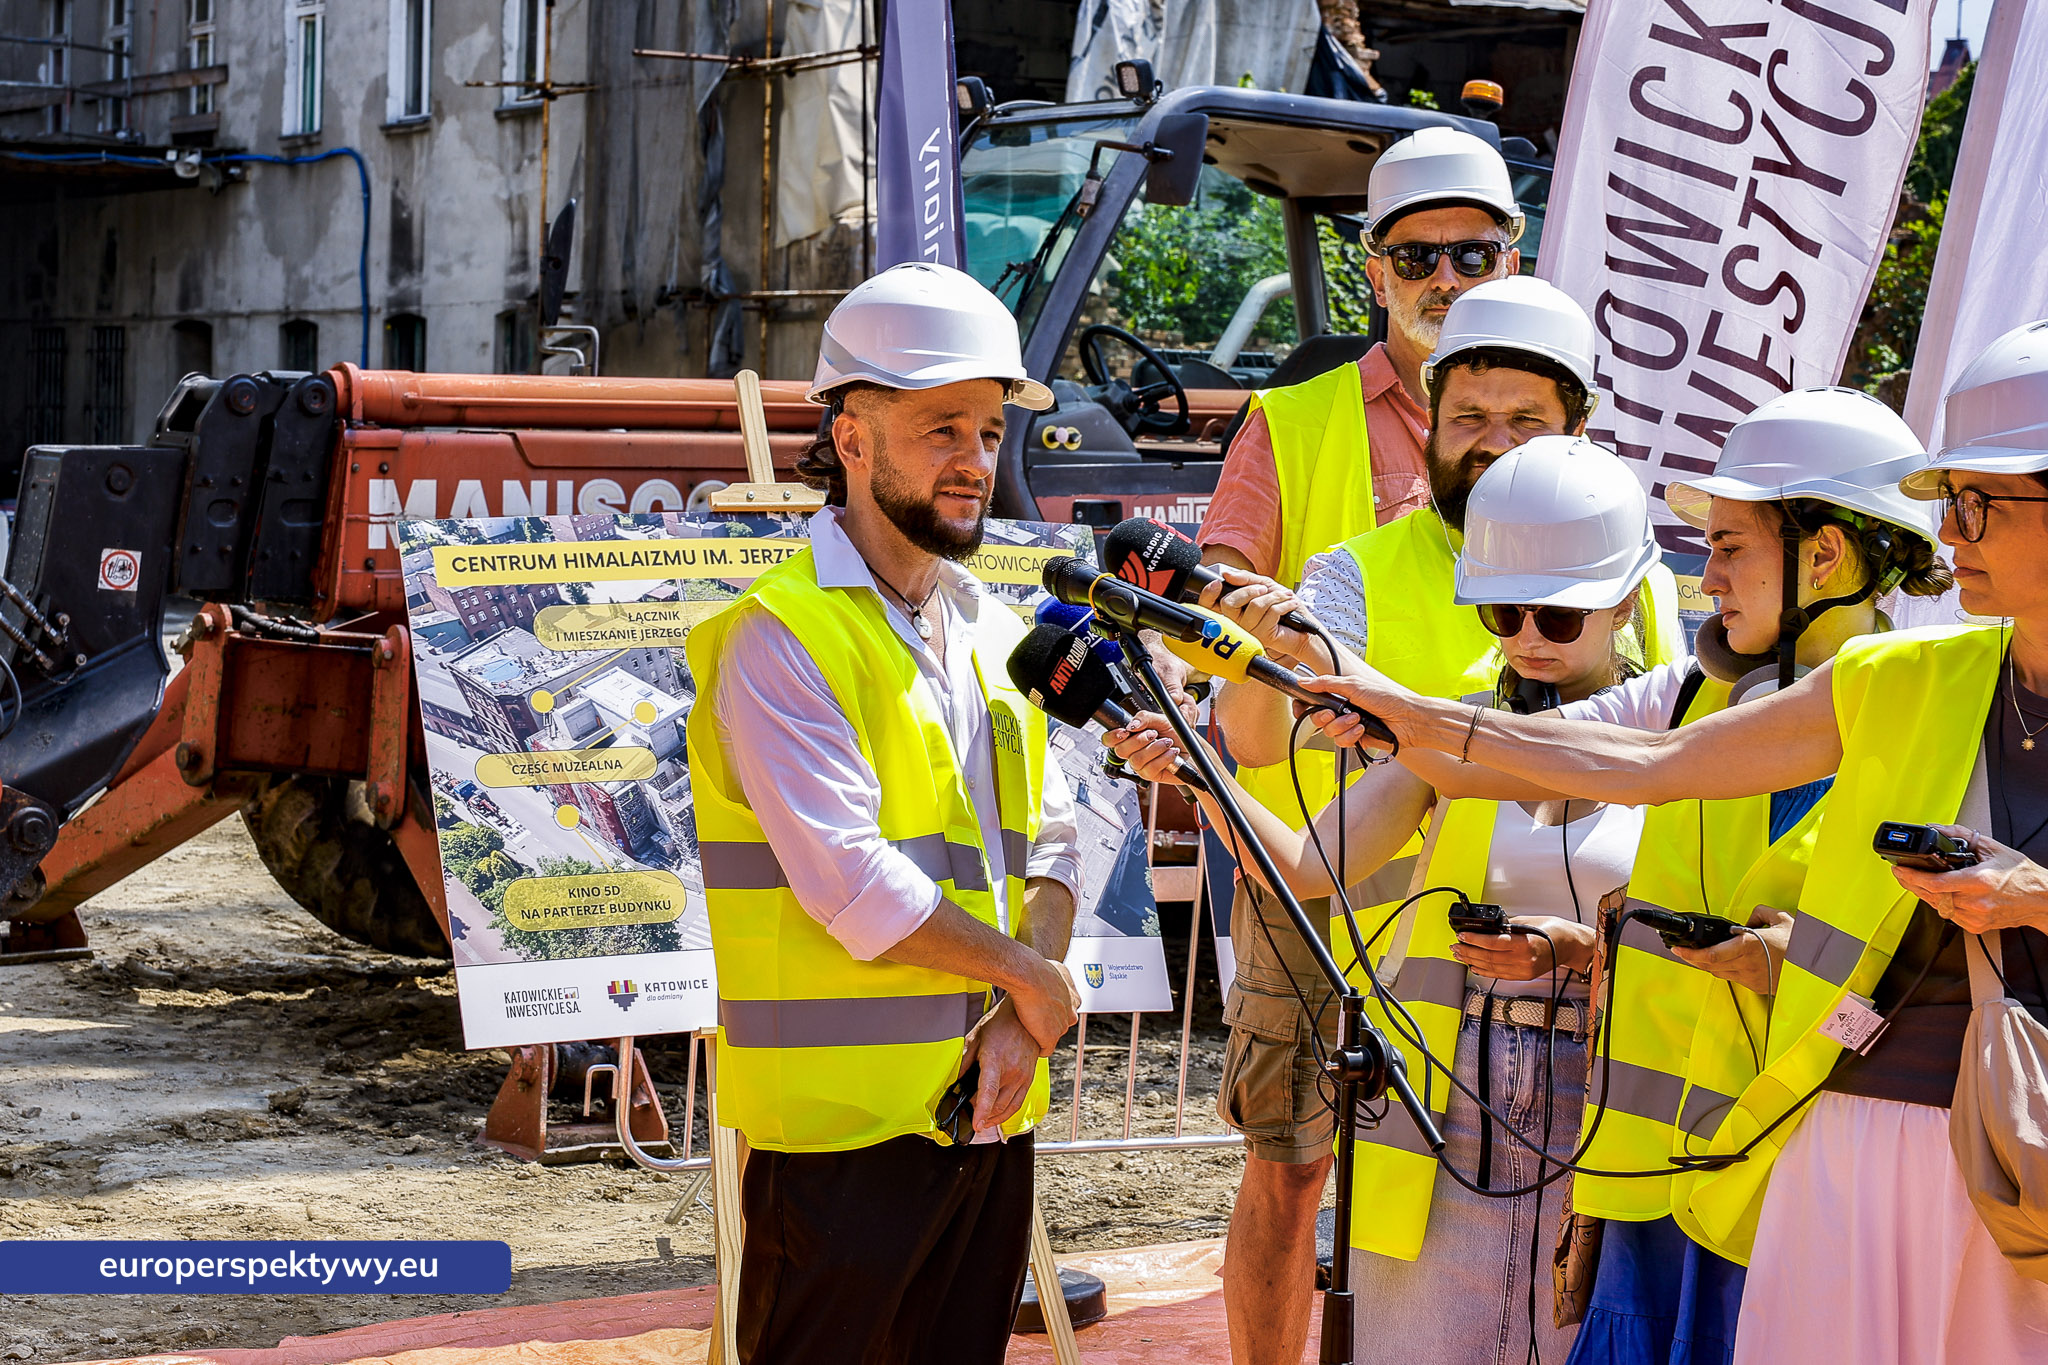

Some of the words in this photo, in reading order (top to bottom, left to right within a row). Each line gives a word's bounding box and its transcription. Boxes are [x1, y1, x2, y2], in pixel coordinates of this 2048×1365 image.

[1142, 531, 1163, 558] RADIO
[1146, 531, 1176, 572] KATOWICE
[451, 553, 557, 573] CENTRUM
[563, 549, 697, 570] HIMALAIZMU
[703, 549, 733, 565] IM.
[740, 548, 804, 564] JERZE
[628, 610, 680, 625] ŁĄCZNIK
[556, 631, 560, 642] I
[564, 629, 637, 642] MIESZKANIE
[640, 627, 691, 642] JERZEGO
[1049, 636, 1088, 695] ANTYRADIO
[511, 760, 550, 777] CZĘŚĆ
[552, 759, 623, 774] MUZEALNA
[568, 886, 601, 899] KINO
[604, 885, 621, 897] 5D
[520, 908, 541, 920] NA
[543, 904, 607, 919] PARTERZE
[609, 899, 672, 915] BUDYNKU
[644, 978, 709, 993] KATOWICE
[504, 987, 563, 1004] KATOWICKIE
[646, 993, 656, 1001] dla
[657, 992, 684, 1001] odmiany
[505, 1002, 566, 1019] INWESTYCJE
